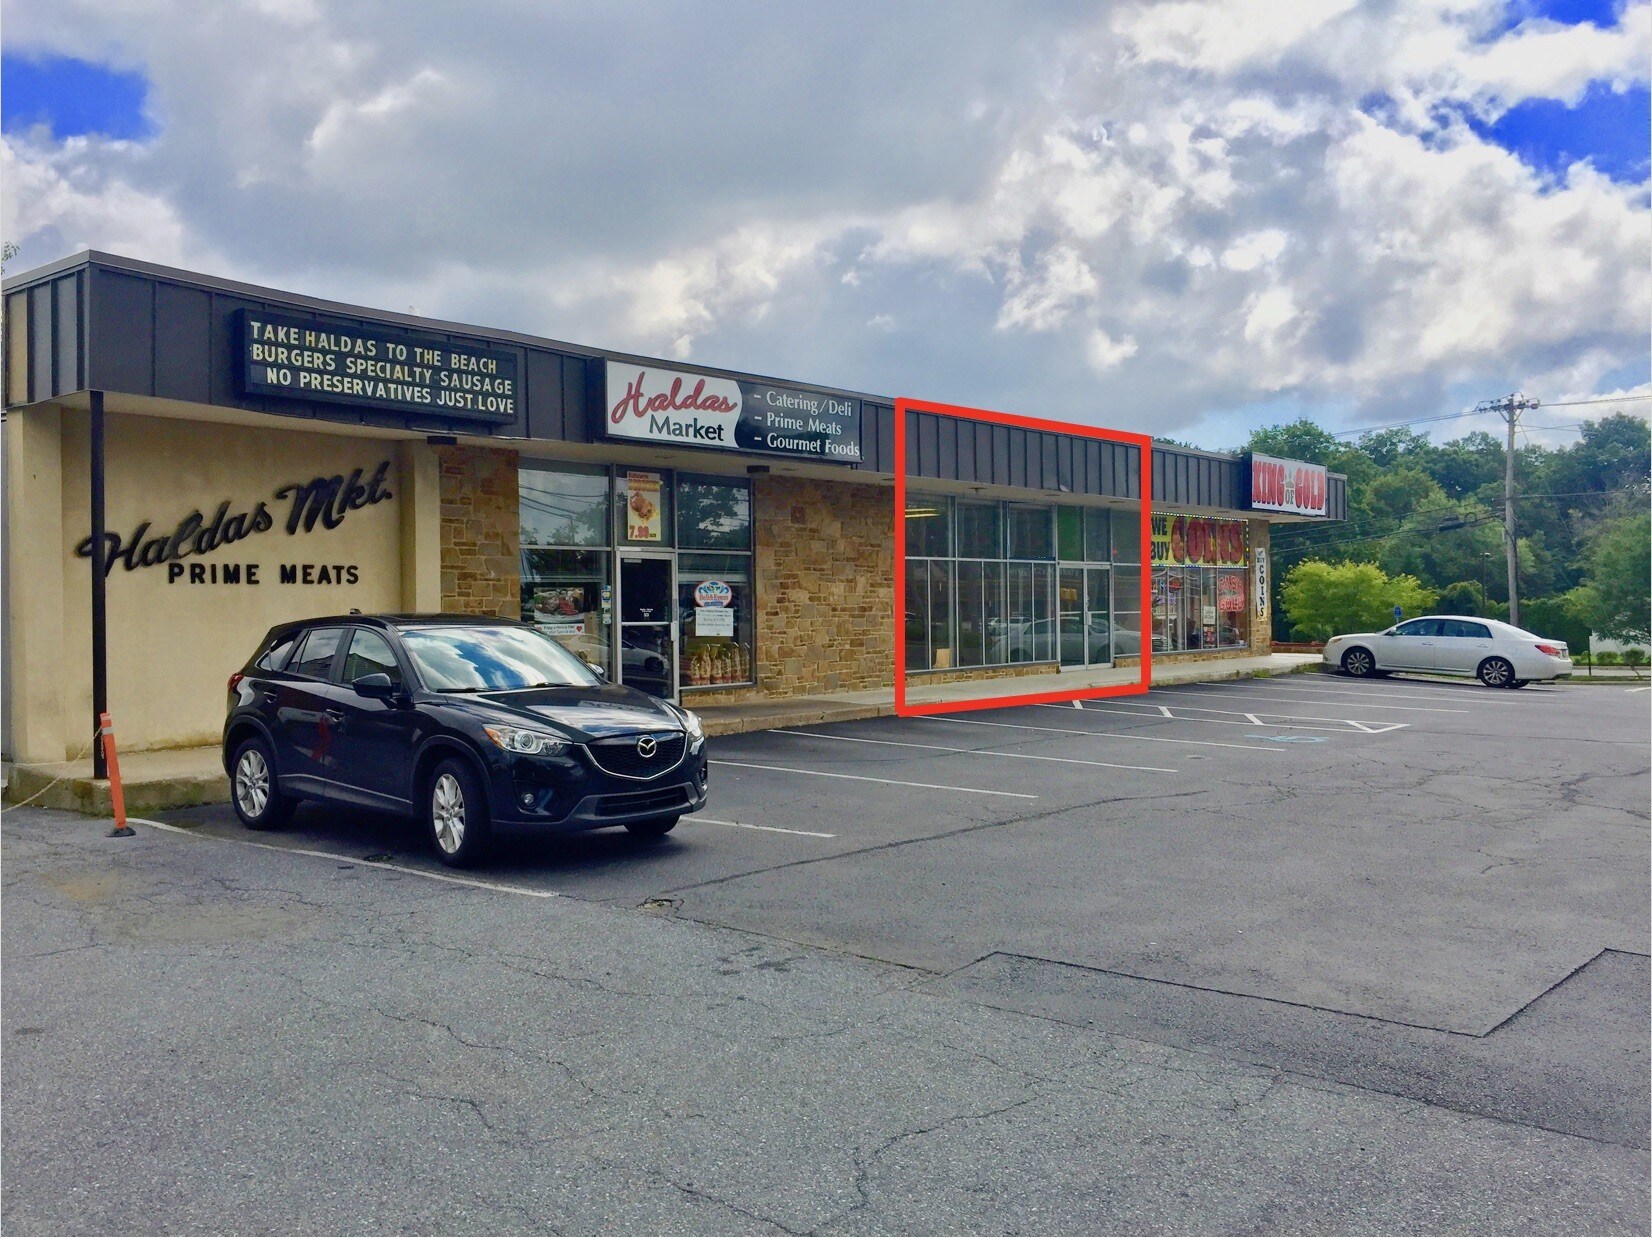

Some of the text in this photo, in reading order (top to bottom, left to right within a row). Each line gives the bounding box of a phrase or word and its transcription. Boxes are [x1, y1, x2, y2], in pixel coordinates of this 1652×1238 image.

[250, 321, 496, 375] TAKE HALDAS TO THE BEACH
[252, 343, 512, 395] BURGERS SPECIALTY SAUSAGE
[266, 367, 514, 414] NO PRESERVATIVES JUST LOVE
[611, 371, 738, 424] Haldas
[766, 391, 852, 416] Catering/Deli
[649, 414, 725, 442] Market
[766, 413, 842, 436] Prime Meats
[766, 432, 860, 457] Gourmet Foods
[1252, 460, 1325, 511] KING OF GOLD
[76, 460, 393, 577] Haldas Mkt.
[1151, 516, 1167, 536] WE
[1151, 541, 1171, 561] BUY
[1171, 515, 1244, 565] COINS
[168, 562, 359, 585] PRIME MEATS
